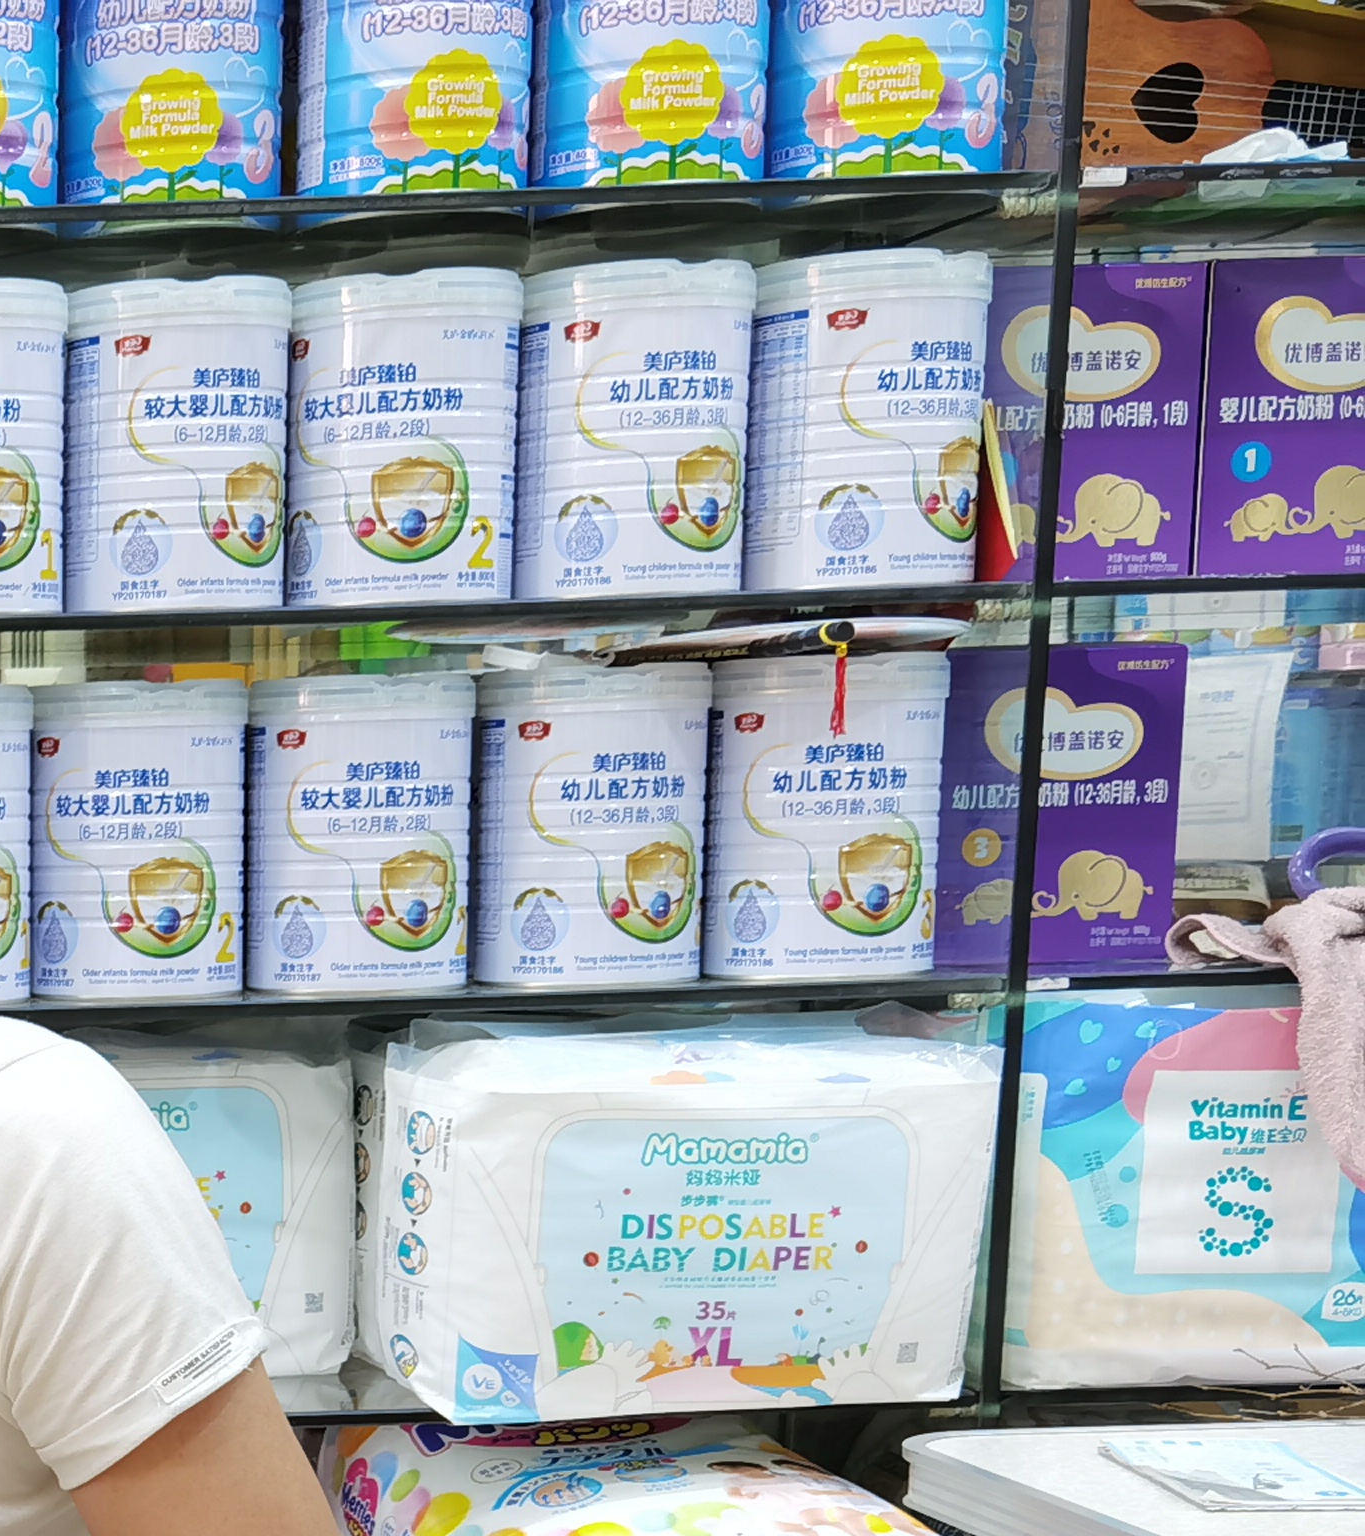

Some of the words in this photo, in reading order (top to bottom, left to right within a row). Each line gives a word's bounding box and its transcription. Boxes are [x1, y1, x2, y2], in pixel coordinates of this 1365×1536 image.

[641, 69, 705, 84] Growing
[857, 62, 922, 79] Growing
[427, 78, 486, 94] Growing
[427, 92, 484, 106] Formula
[161, 123, 216, 136] Powder
[643, 350, 717, 372] 美庐臻铂
[193, 367, 261, 389] 美庐臻铂
[339, 363, 417, 388] 美庐臻铂
[609, 377, 735, 404] 幼儿配方奶粉
[304, 388, 464, 421] 较大婴儿配方奶粉
[1219, 396, 1334, 423] 婴儿配方奶粉
[1244, 448, 1257, 473] 1
[592, 751, 666, 772] 美庐臻铂
[804, 742, 885, 764] 美庐臻铂
[94, 768, 170, 789] 美庐臻铂
[346, 760, 421, 781] 美庐臻铂
[772, 768, 908, 795] 幼儿配方奶粉
[300, 785, 455, 811] 较大婴儿配方奶粉
[560, 775, 686, 802] 幼儿配方奶粉
[55, 791, 211, 817] 较大婴儿配方奶粉
[975, 836, 989, 859] 3
[1189, 1097, 1284, 1122] Vitamin
[1287, 1095, 1309, 1121] E
[1188, 1120, 1249, 1145] Baby
[641, 1133, 808, 1166] Mamamia
[686, 1169, 761, 1187] 妈妈米娅
[1197, 1166, 1274, 1257] S
[621, 1213, 825, 1240] DISPOSABLE
[607, 1247, 696, 1272] BABY
[712, 1246, 833, 1272] DIAPER
[688, 1326, 743, 1367] XL
